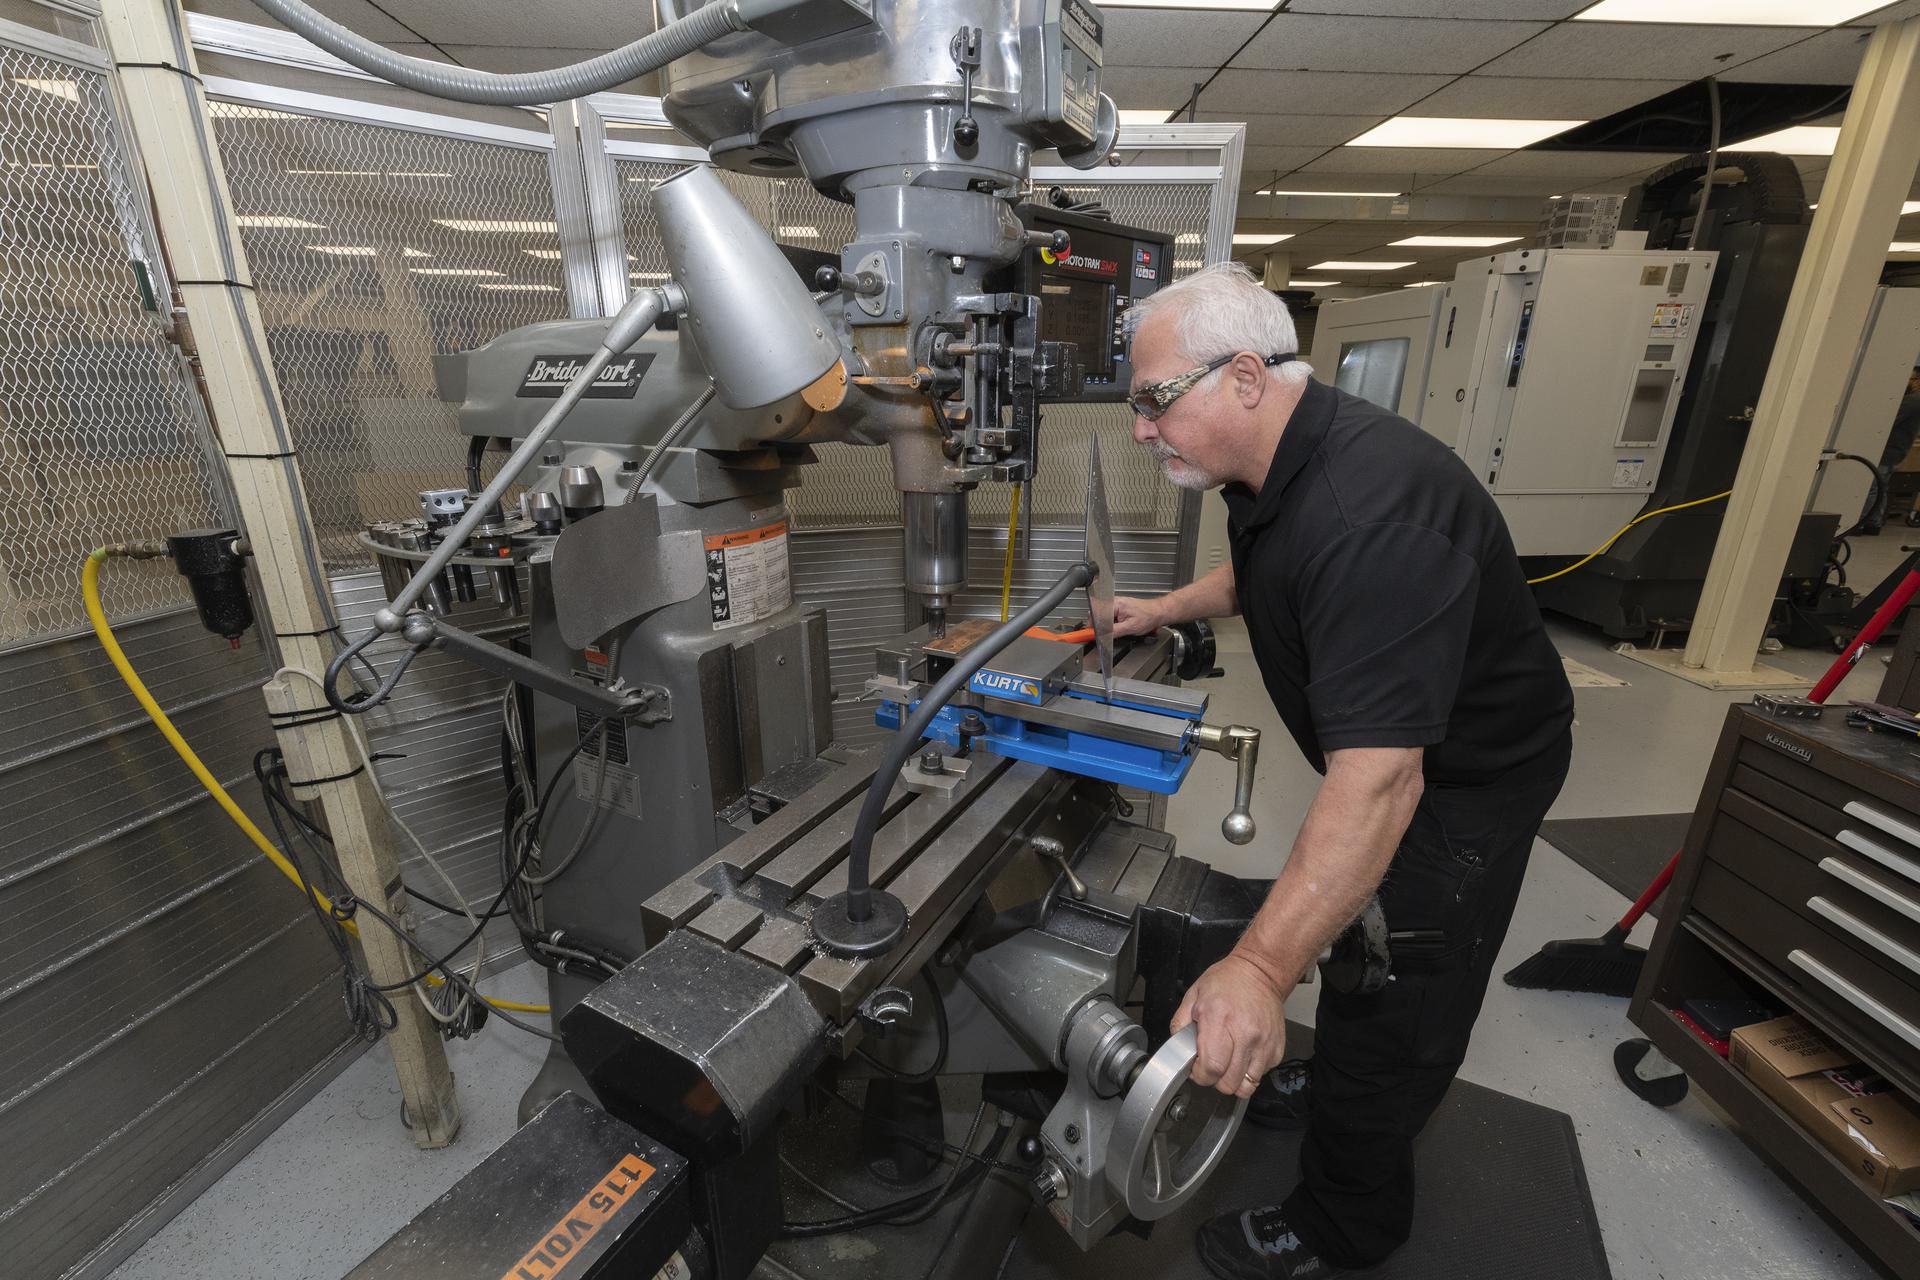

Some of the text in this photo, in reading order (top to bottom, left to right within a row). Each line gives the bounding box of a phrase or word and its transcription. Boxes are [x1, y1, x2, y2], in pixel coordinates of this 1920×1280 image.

[527, 359, 636, 393] Bridgort
[973, 672, 1023, 691] KURT
[1765, 732, 1812, 762] Kennedy
[1850, 1107, 1873, 1125] S
[1862, 1159, 1876, 1177] S
[588, 1166, 642, 1214] 115
